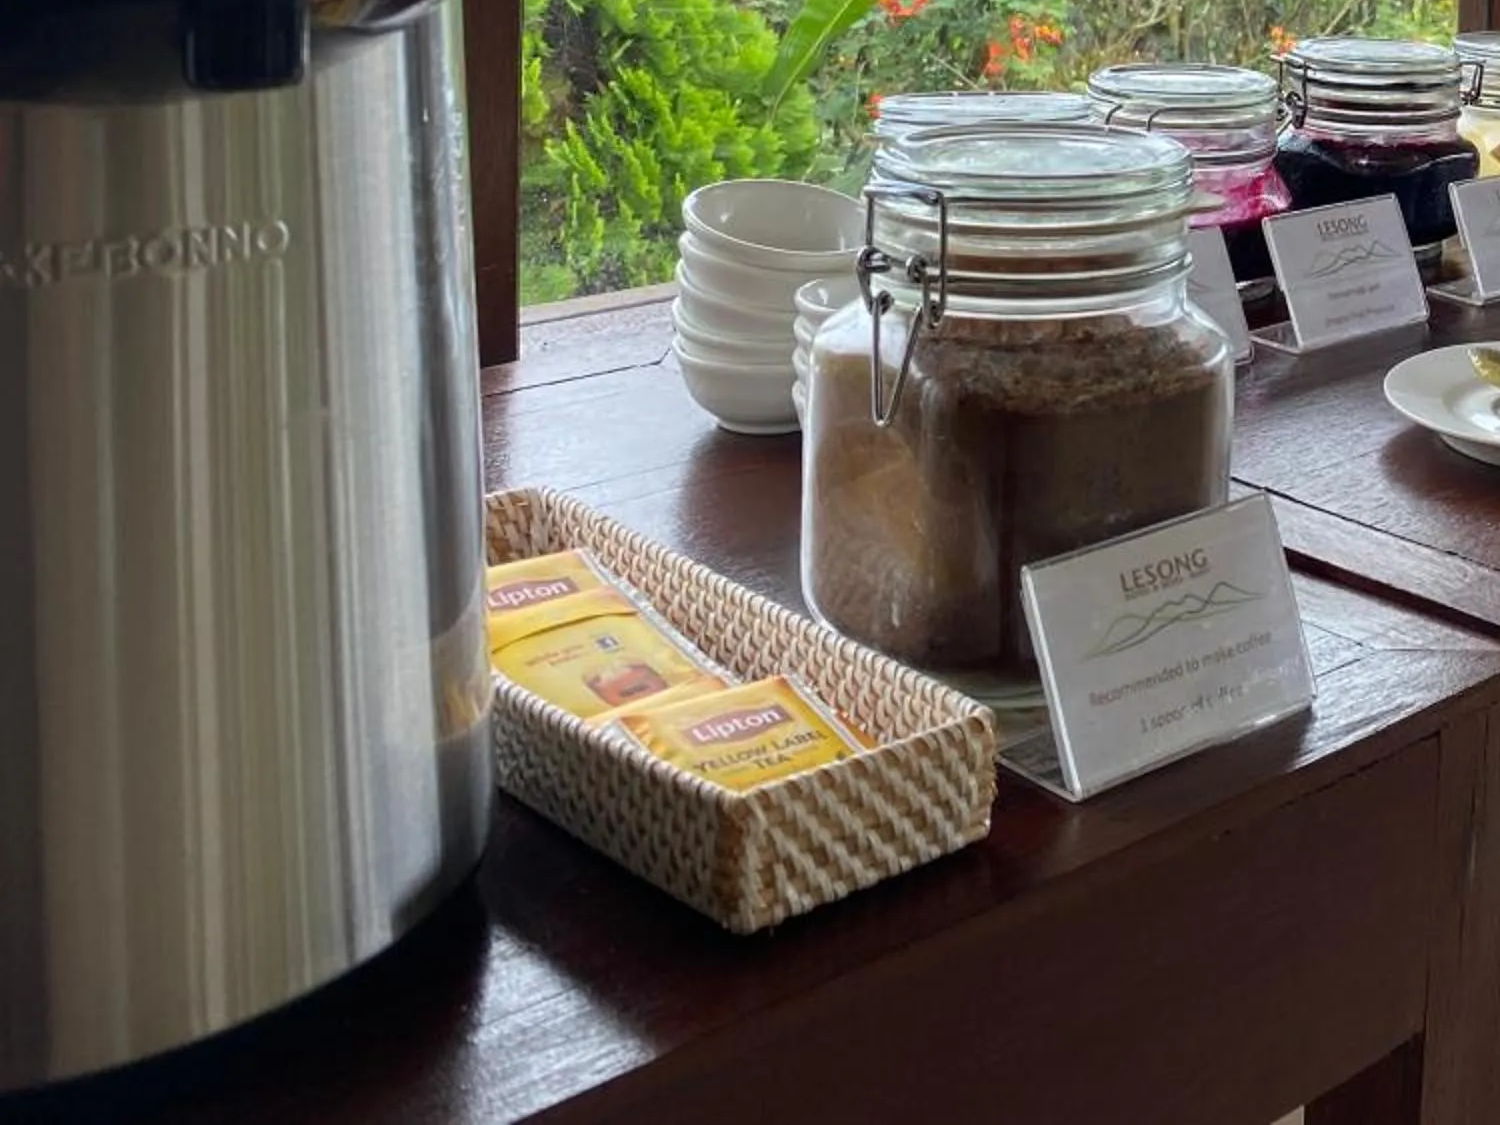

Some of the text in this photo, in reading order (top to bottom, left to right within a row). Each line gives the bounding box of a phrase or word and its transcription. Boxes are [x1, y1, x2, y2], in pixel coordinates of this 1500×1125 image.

[1119, 548, 1208, 593] LESONG
[488, 580, 570, 608] Lipton
[691, 709, 779, 743] Lipton
[693, 729, 828, 774] YELLOW LABEL
[752, 755, 791, 771] TEA
